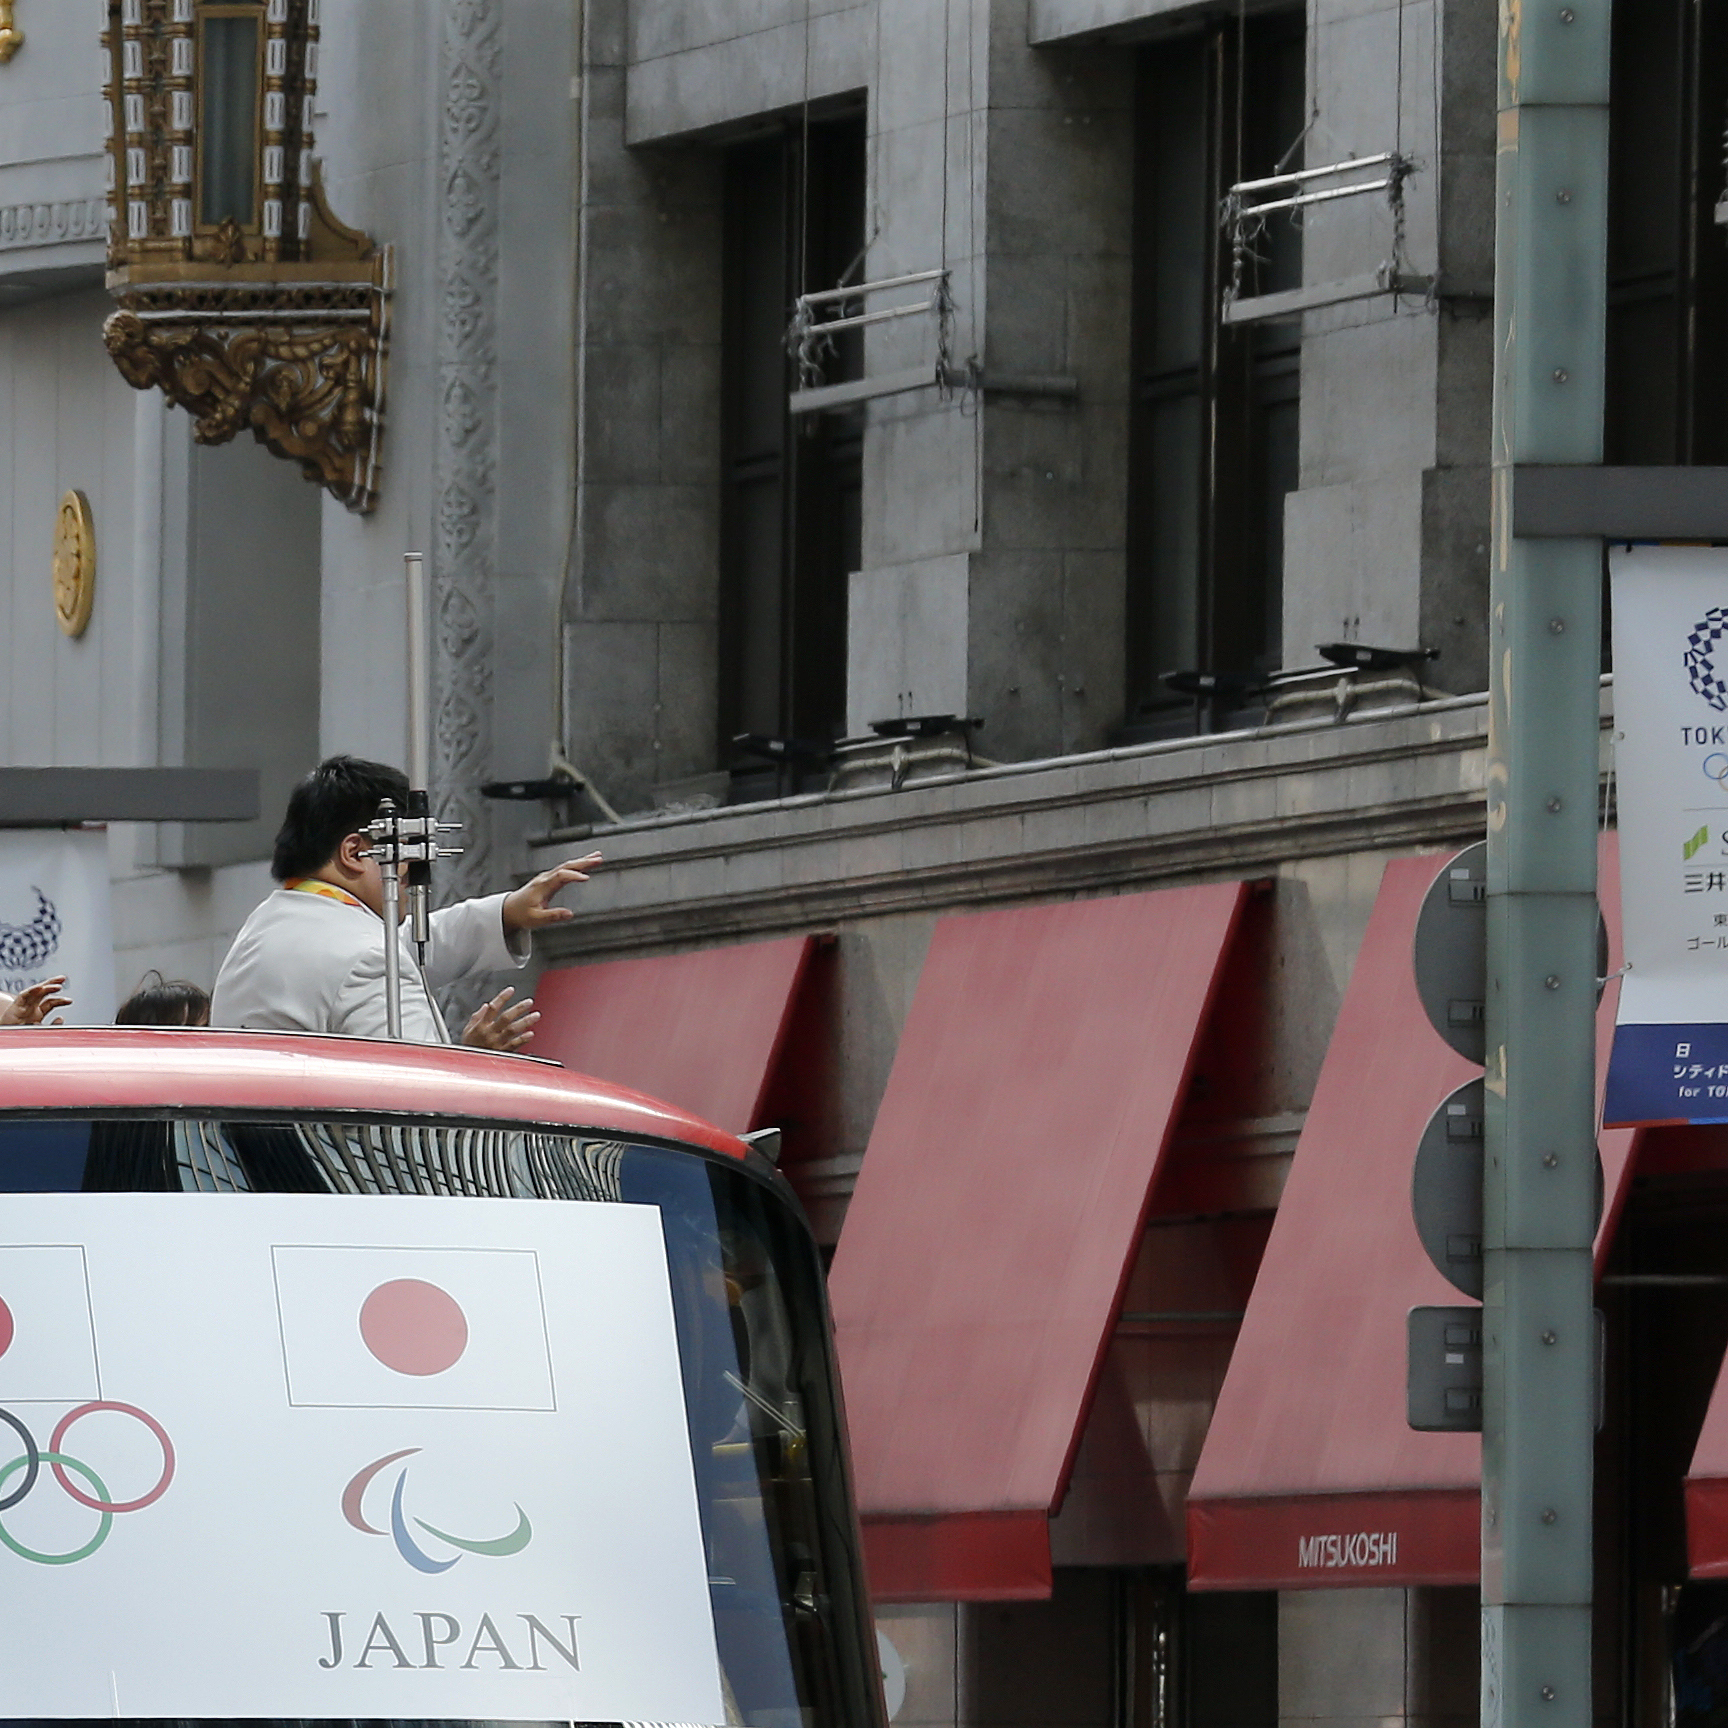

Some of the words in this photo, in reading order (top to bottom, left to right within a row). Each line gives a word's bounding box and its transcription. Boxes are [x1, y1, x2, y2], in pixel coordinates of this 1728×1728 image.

[1682, 726, 1728, 746] TOK
[1676, 1042, 1691, 1058] 日
[1678, 1085, 1701, 1098] for
[1707, 1084, 1728, 1098] TO
[1298, 1532, 1397, 1568] MITSUKOSHI
[317, 1610, 584, 1673] JAPAN
